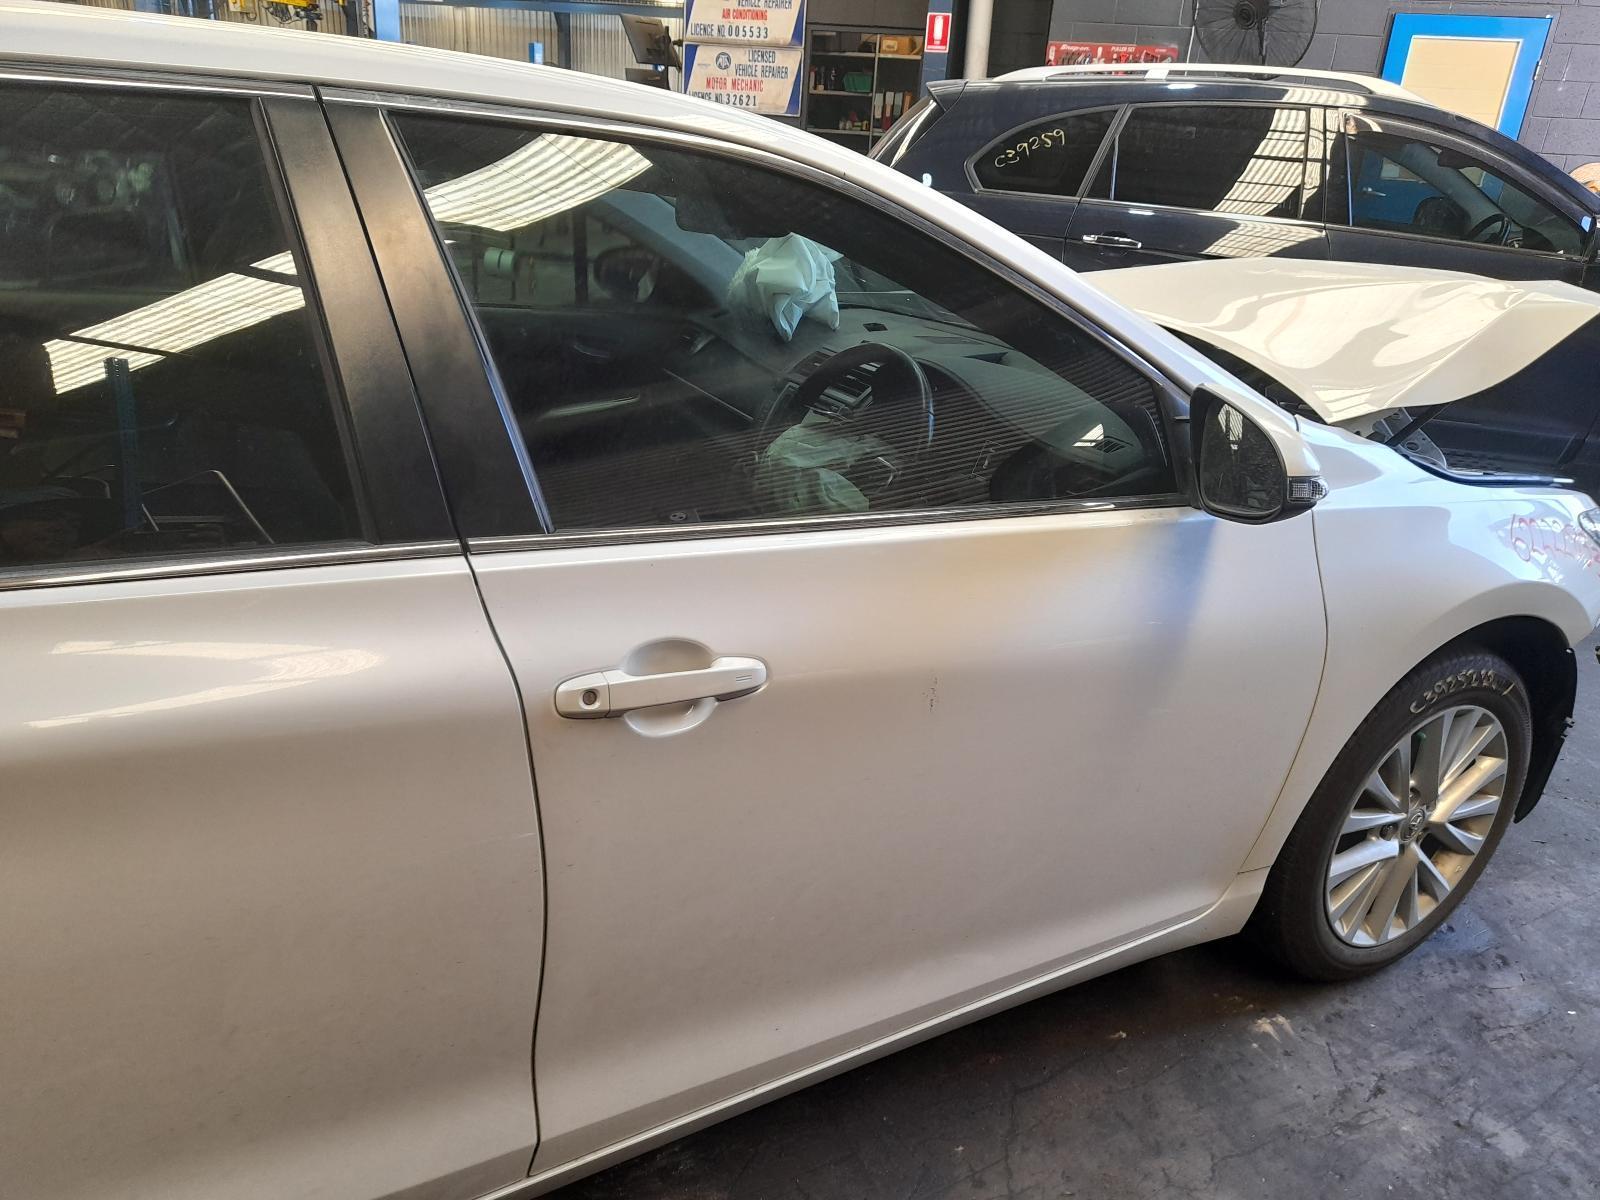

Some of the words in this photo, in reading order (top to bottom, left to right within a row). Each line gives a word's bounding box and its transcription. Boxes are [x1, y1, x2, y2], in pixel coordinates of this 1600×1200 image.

[722, 8, 731, 20] AIR
[732, 9, 768, 21] CONDITIONING
[690, 22, 714, 37] LICENCE
[727, 25, 768, 39] 005533
[747, 50, 776, 64] LICENSED
[734, 64, 758, 78] VEHICLE
[761, 66, 788, 79] REPAIRER
[706, 77, 728, 90] MOTOR
[731, 79, 764, 93] MECHANIC
[725, 93, 757, 107] 32621
[994, 128, 1065, 168] C39259
